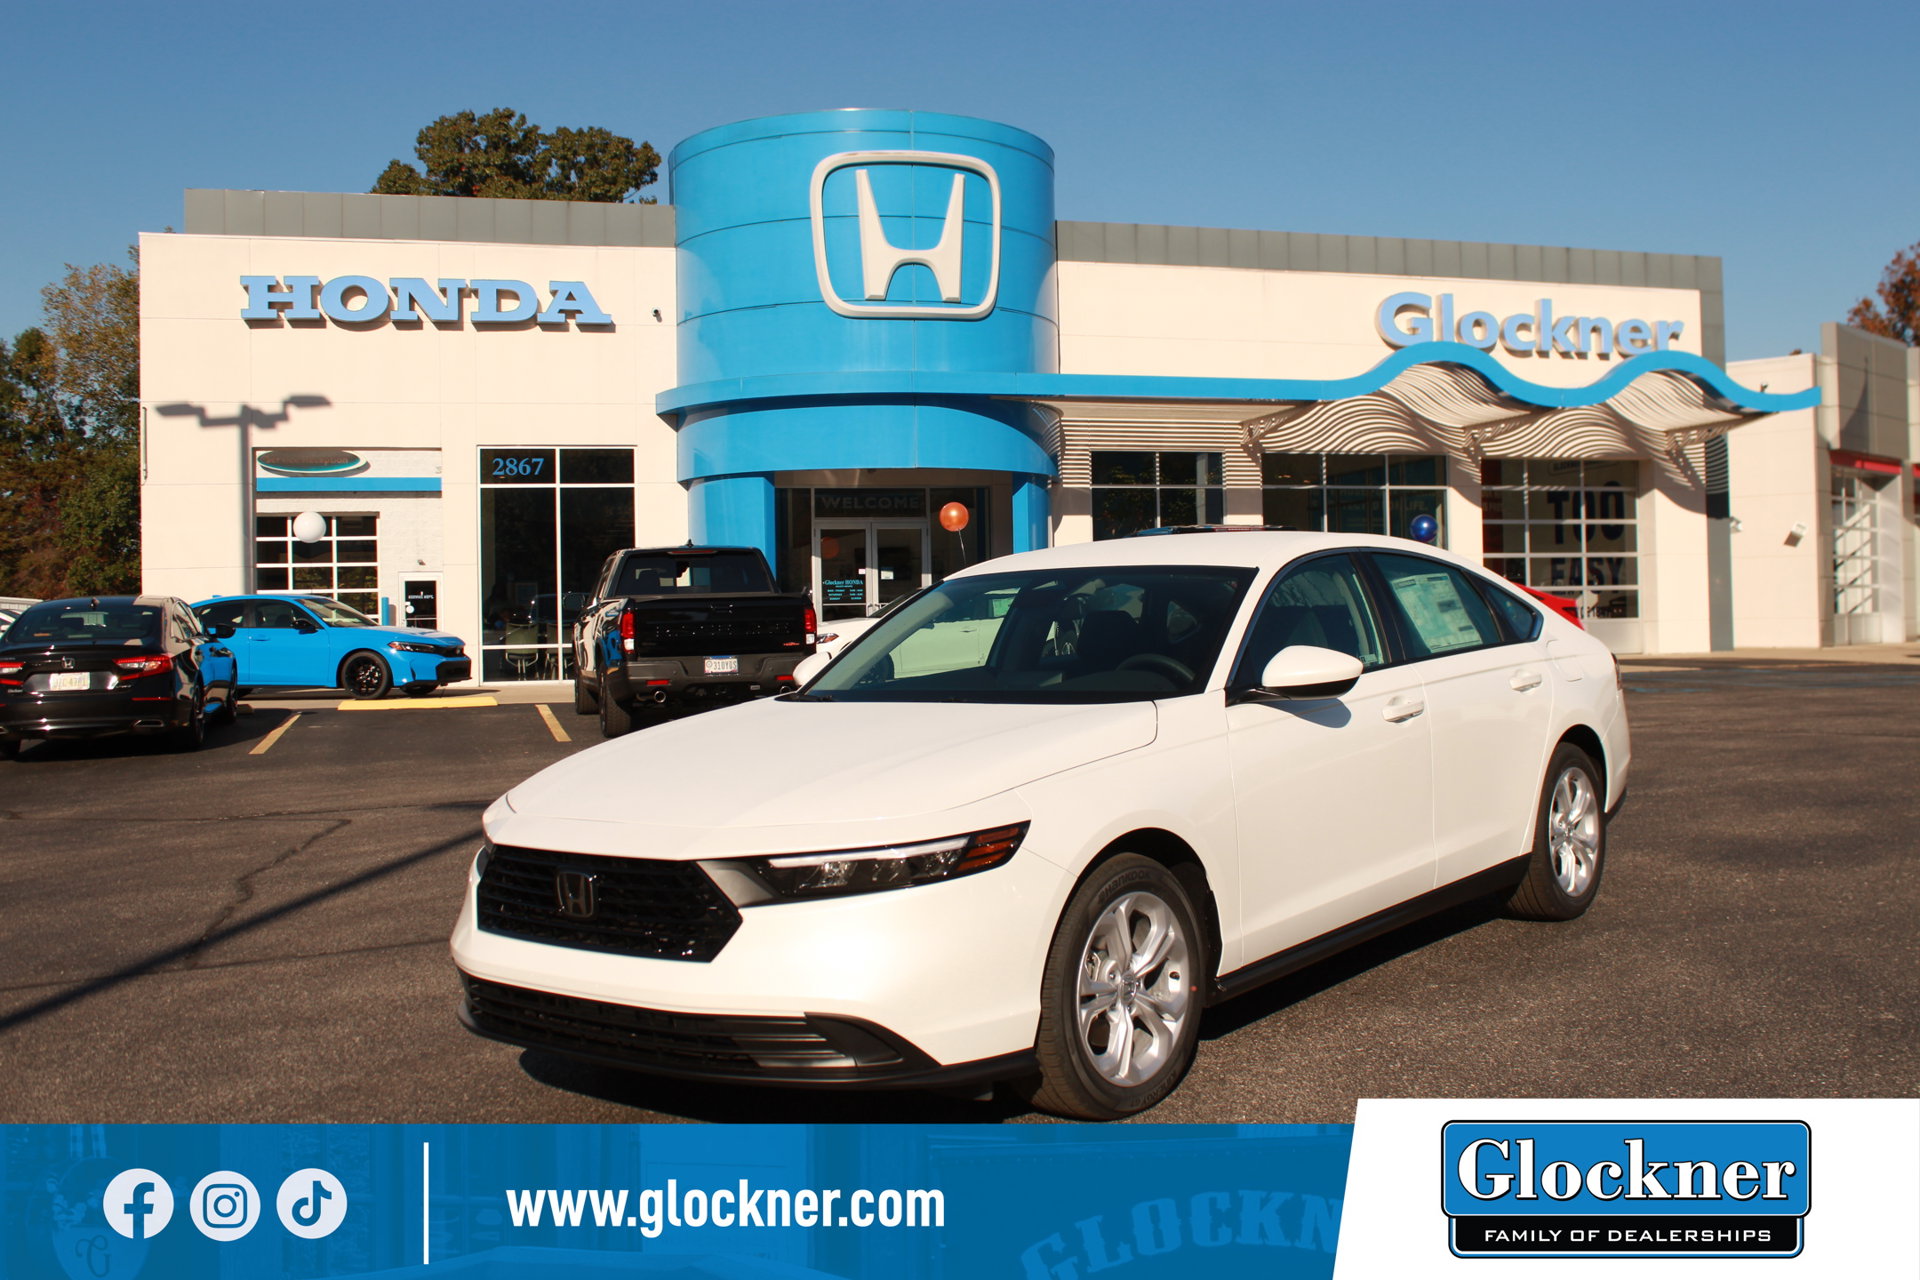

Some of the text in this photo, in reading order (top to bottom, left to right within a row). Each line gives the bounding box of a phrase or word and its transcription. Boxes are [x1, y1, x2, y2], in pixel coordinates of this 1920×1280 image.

[240, 275, 613, 327] HONDA
[1375, 291, 1685, 352] Glockner
[492, 457, 545, 476] 2867
[821, 496, 920, 509] WELCOME
[1546, 481, 1625, 545] TOO
[1551, 554, 1625, 595] EASY
